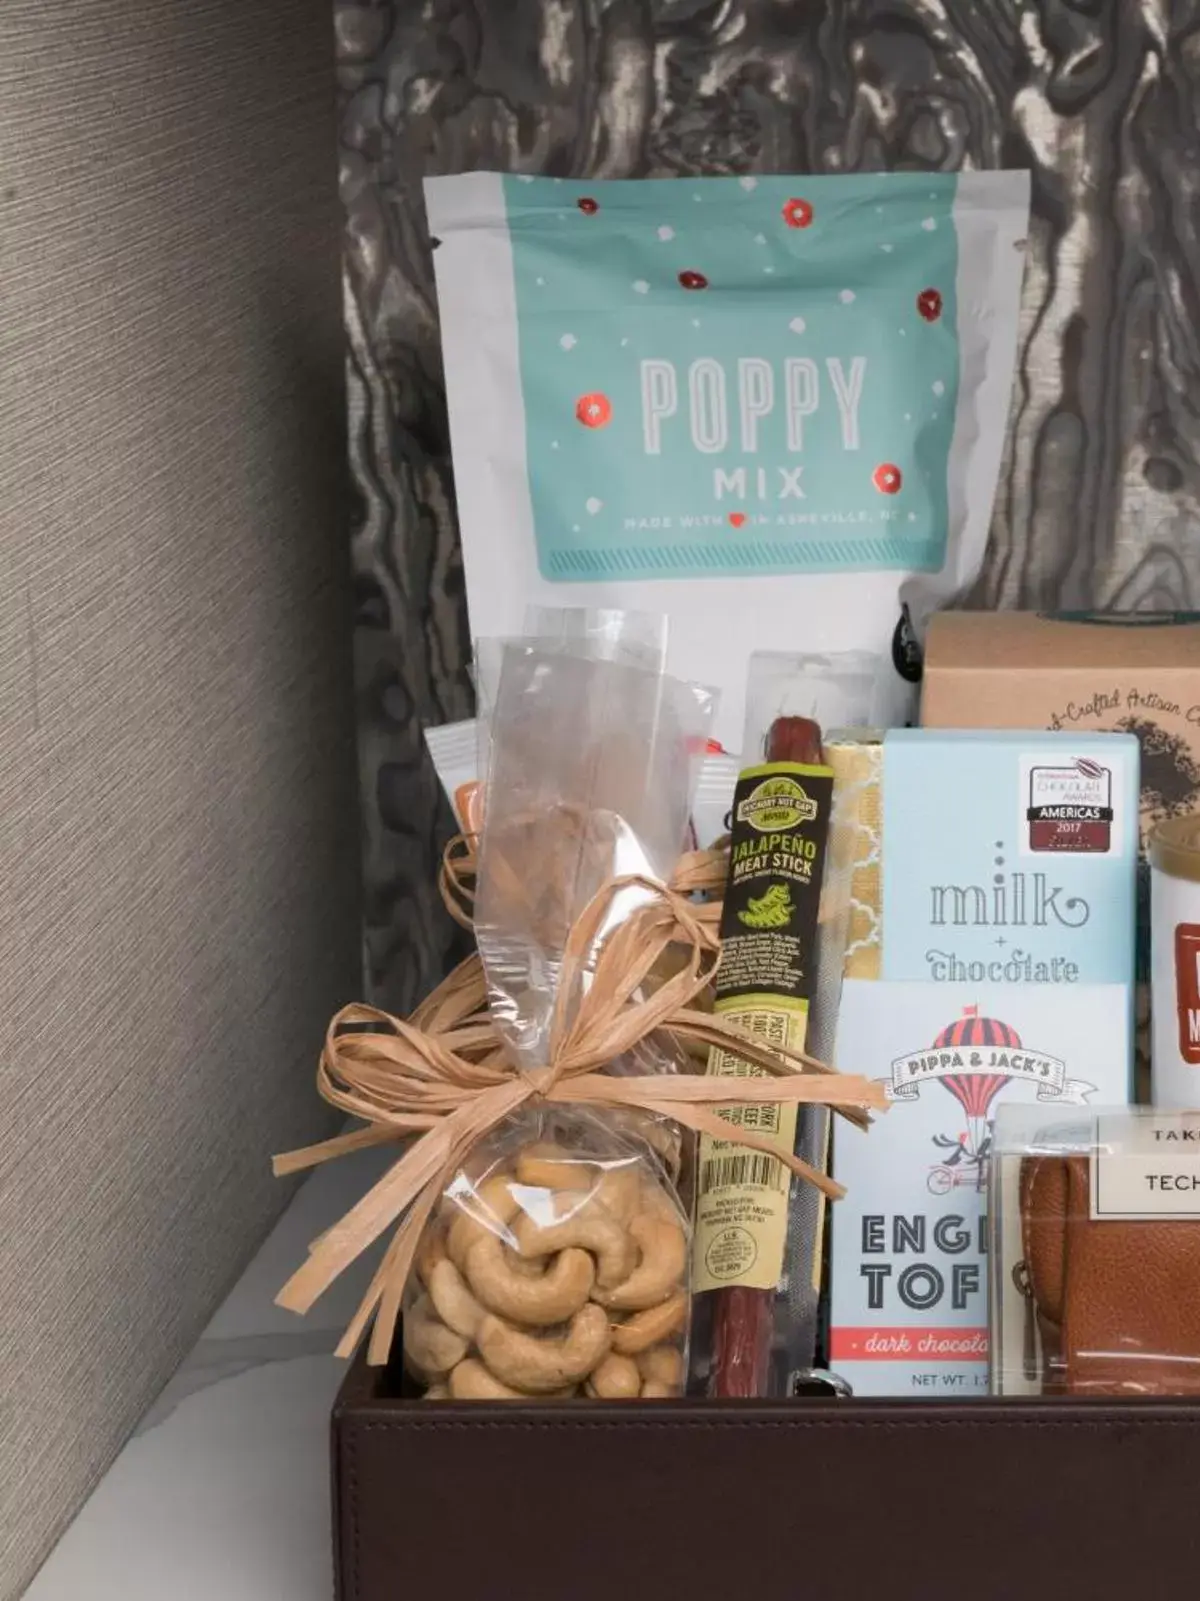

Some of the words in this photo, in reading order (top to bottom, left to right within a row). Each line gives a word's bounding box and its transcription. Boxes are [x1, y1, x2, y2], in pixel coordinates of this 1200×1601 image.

[640, 356, 868, 455] POPPY
[713, 466, 807, 500] MIX
[681, 514, 723, 528] WITH
[1046, 688, 1121, 732] d-Crafted
[1127, 687, 1182, 716] Artisan
[1040, 807, 1101, 819] AMERICAS
[1056, 822, 1082, 833] 2017
[733, 833, 817, 863] JALAPEÑO
[733, 854, 768, 877] MEAT
[772, 853, 813, 876] STICK
[930, 871, 1091, 929] milk
[925, 949, 1080, 984] chocolate
[908, 1051, 964, 1076] PIPPA
[970, 1051, 983, 1067] &
[988, 1051, 1051, 1078] JACK'S
[865, 1332, 912, 1353] dark
[911, 1375, 937, 1387] NET
